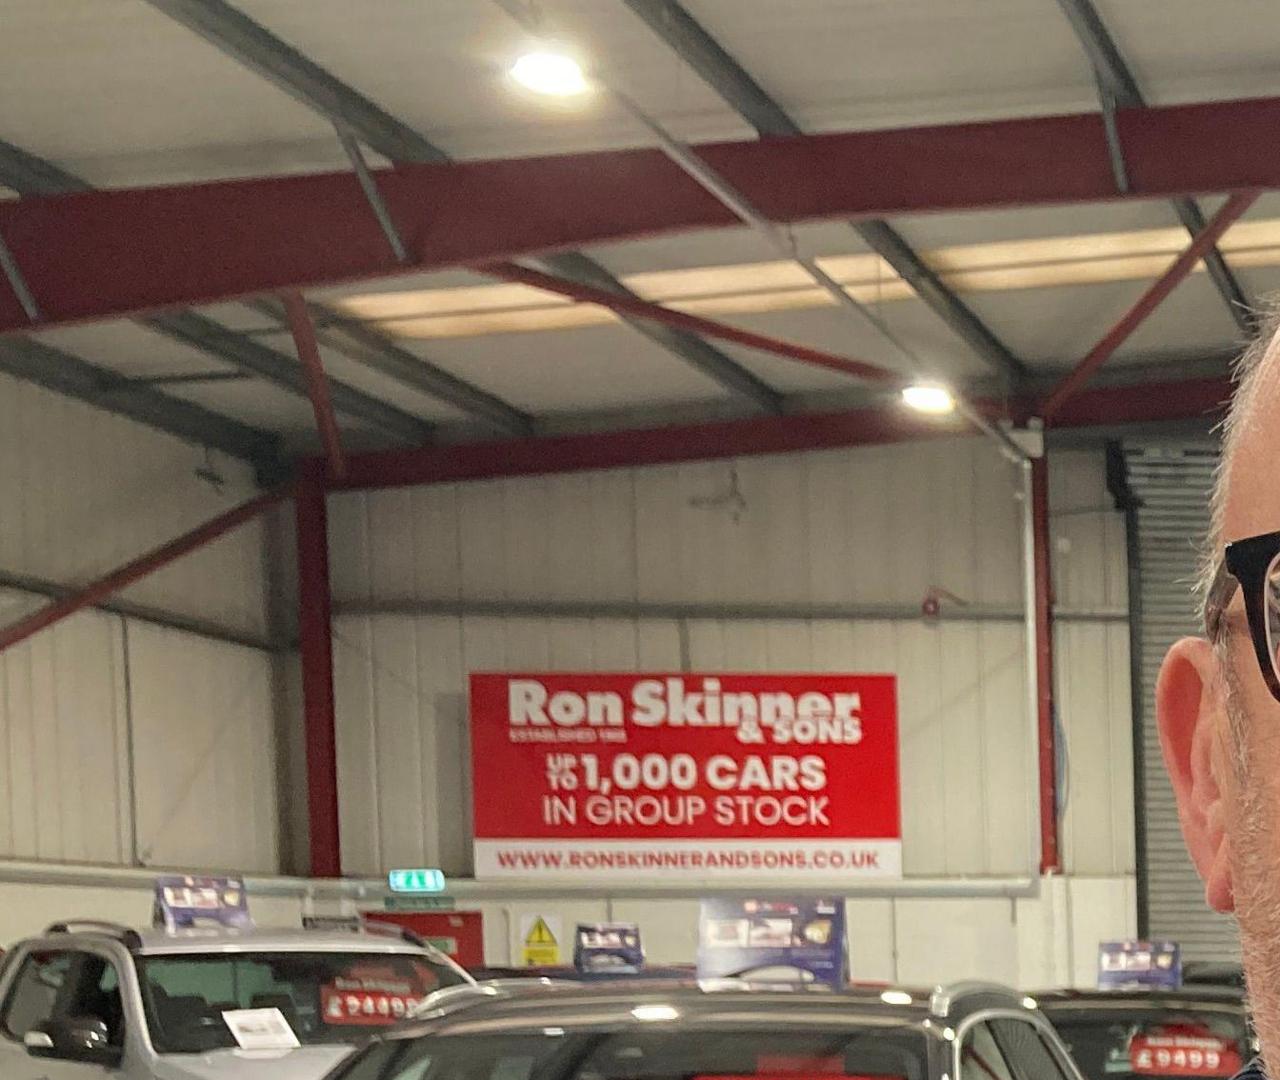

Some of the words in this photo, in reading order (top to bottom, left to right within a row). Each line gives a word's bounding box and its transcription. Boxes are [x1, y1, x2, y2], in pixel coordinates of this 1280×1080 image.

[508, 679, 624, 727] Ron
[631, 677, 861, 727] Skinner
[773, 718, 862, 744] SONS
[580, 752, 697, 795] 1,000
[706, 754, 828, 791] CARS
[542, 796, 577, 826] IN
[585, 795, 706, 826] GROUP
[713, 796, 830, 826] STOCK
[498, 851, 879, 869] WWW.RONSKINNERANDSONS.CO.UK
